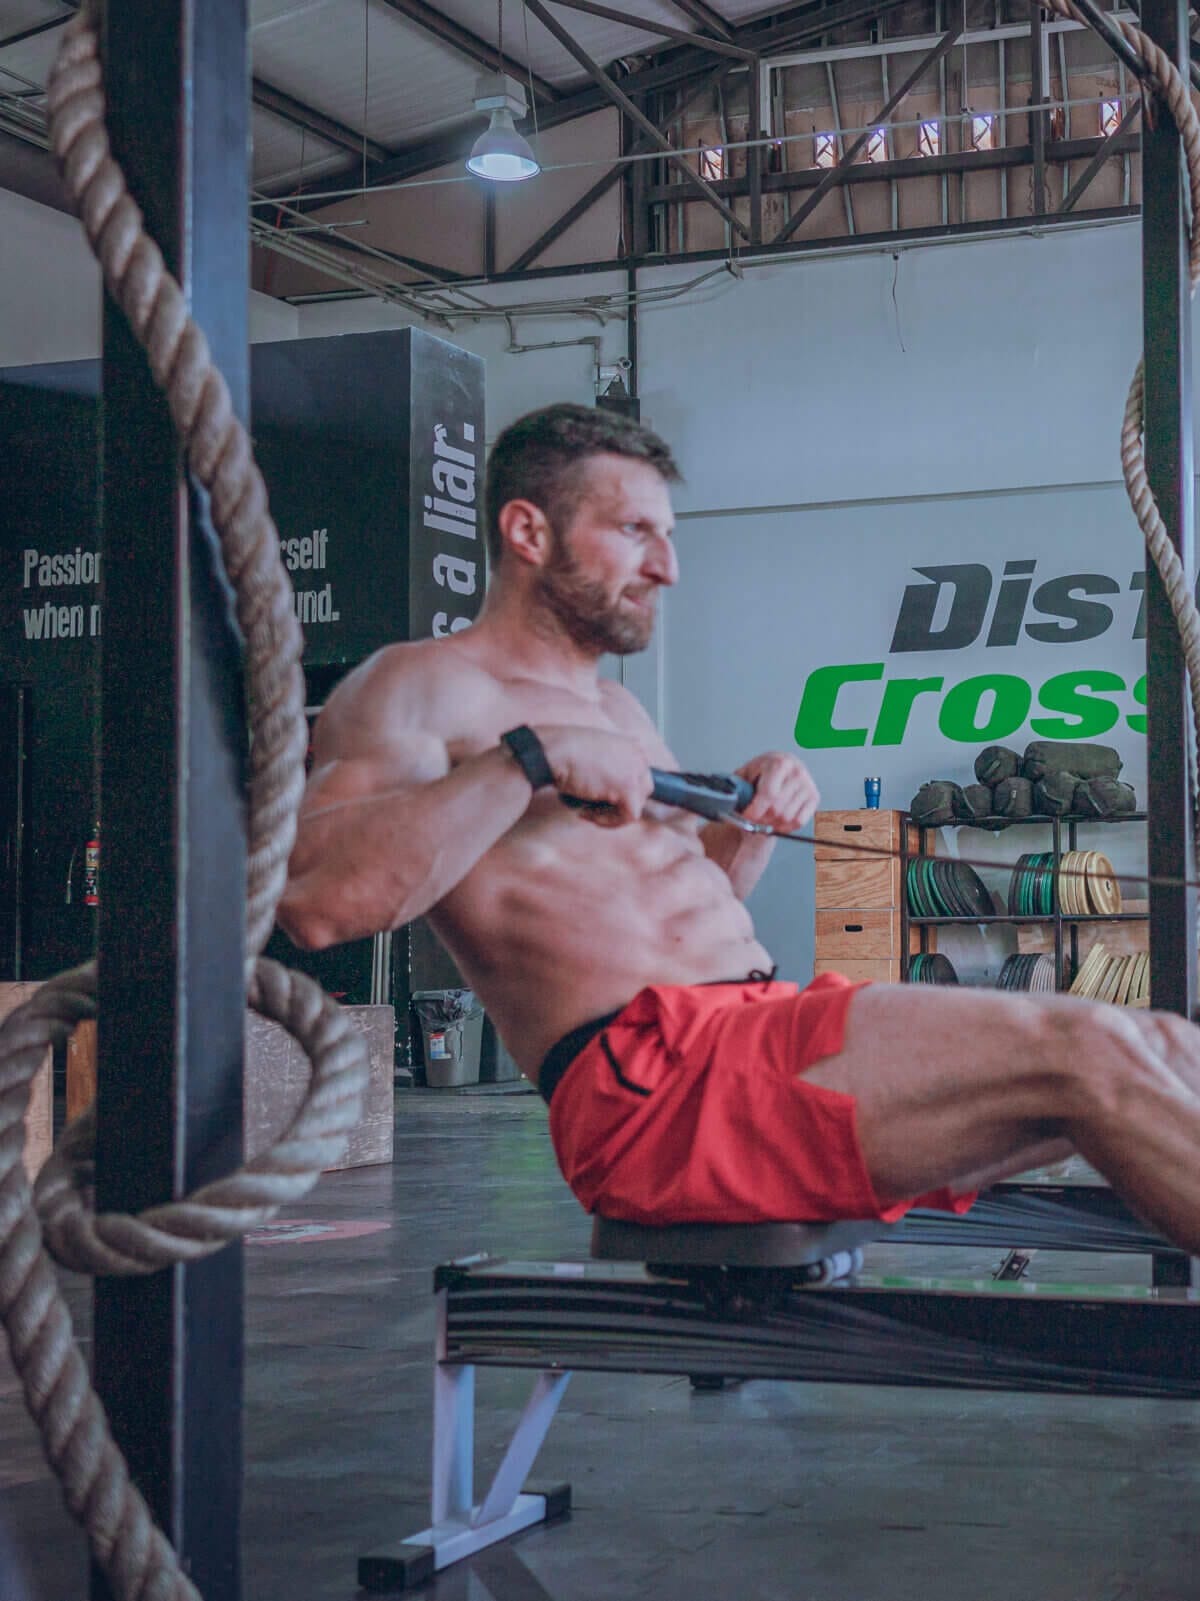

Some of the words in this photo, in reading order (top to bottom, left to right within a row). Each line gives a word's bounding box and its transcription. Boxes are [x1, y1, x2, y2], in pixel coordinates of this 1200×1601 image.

[423, 422, 477, 540] liar.
[432, 553, 476, 596] a
[23, 601, 84, 640] when
